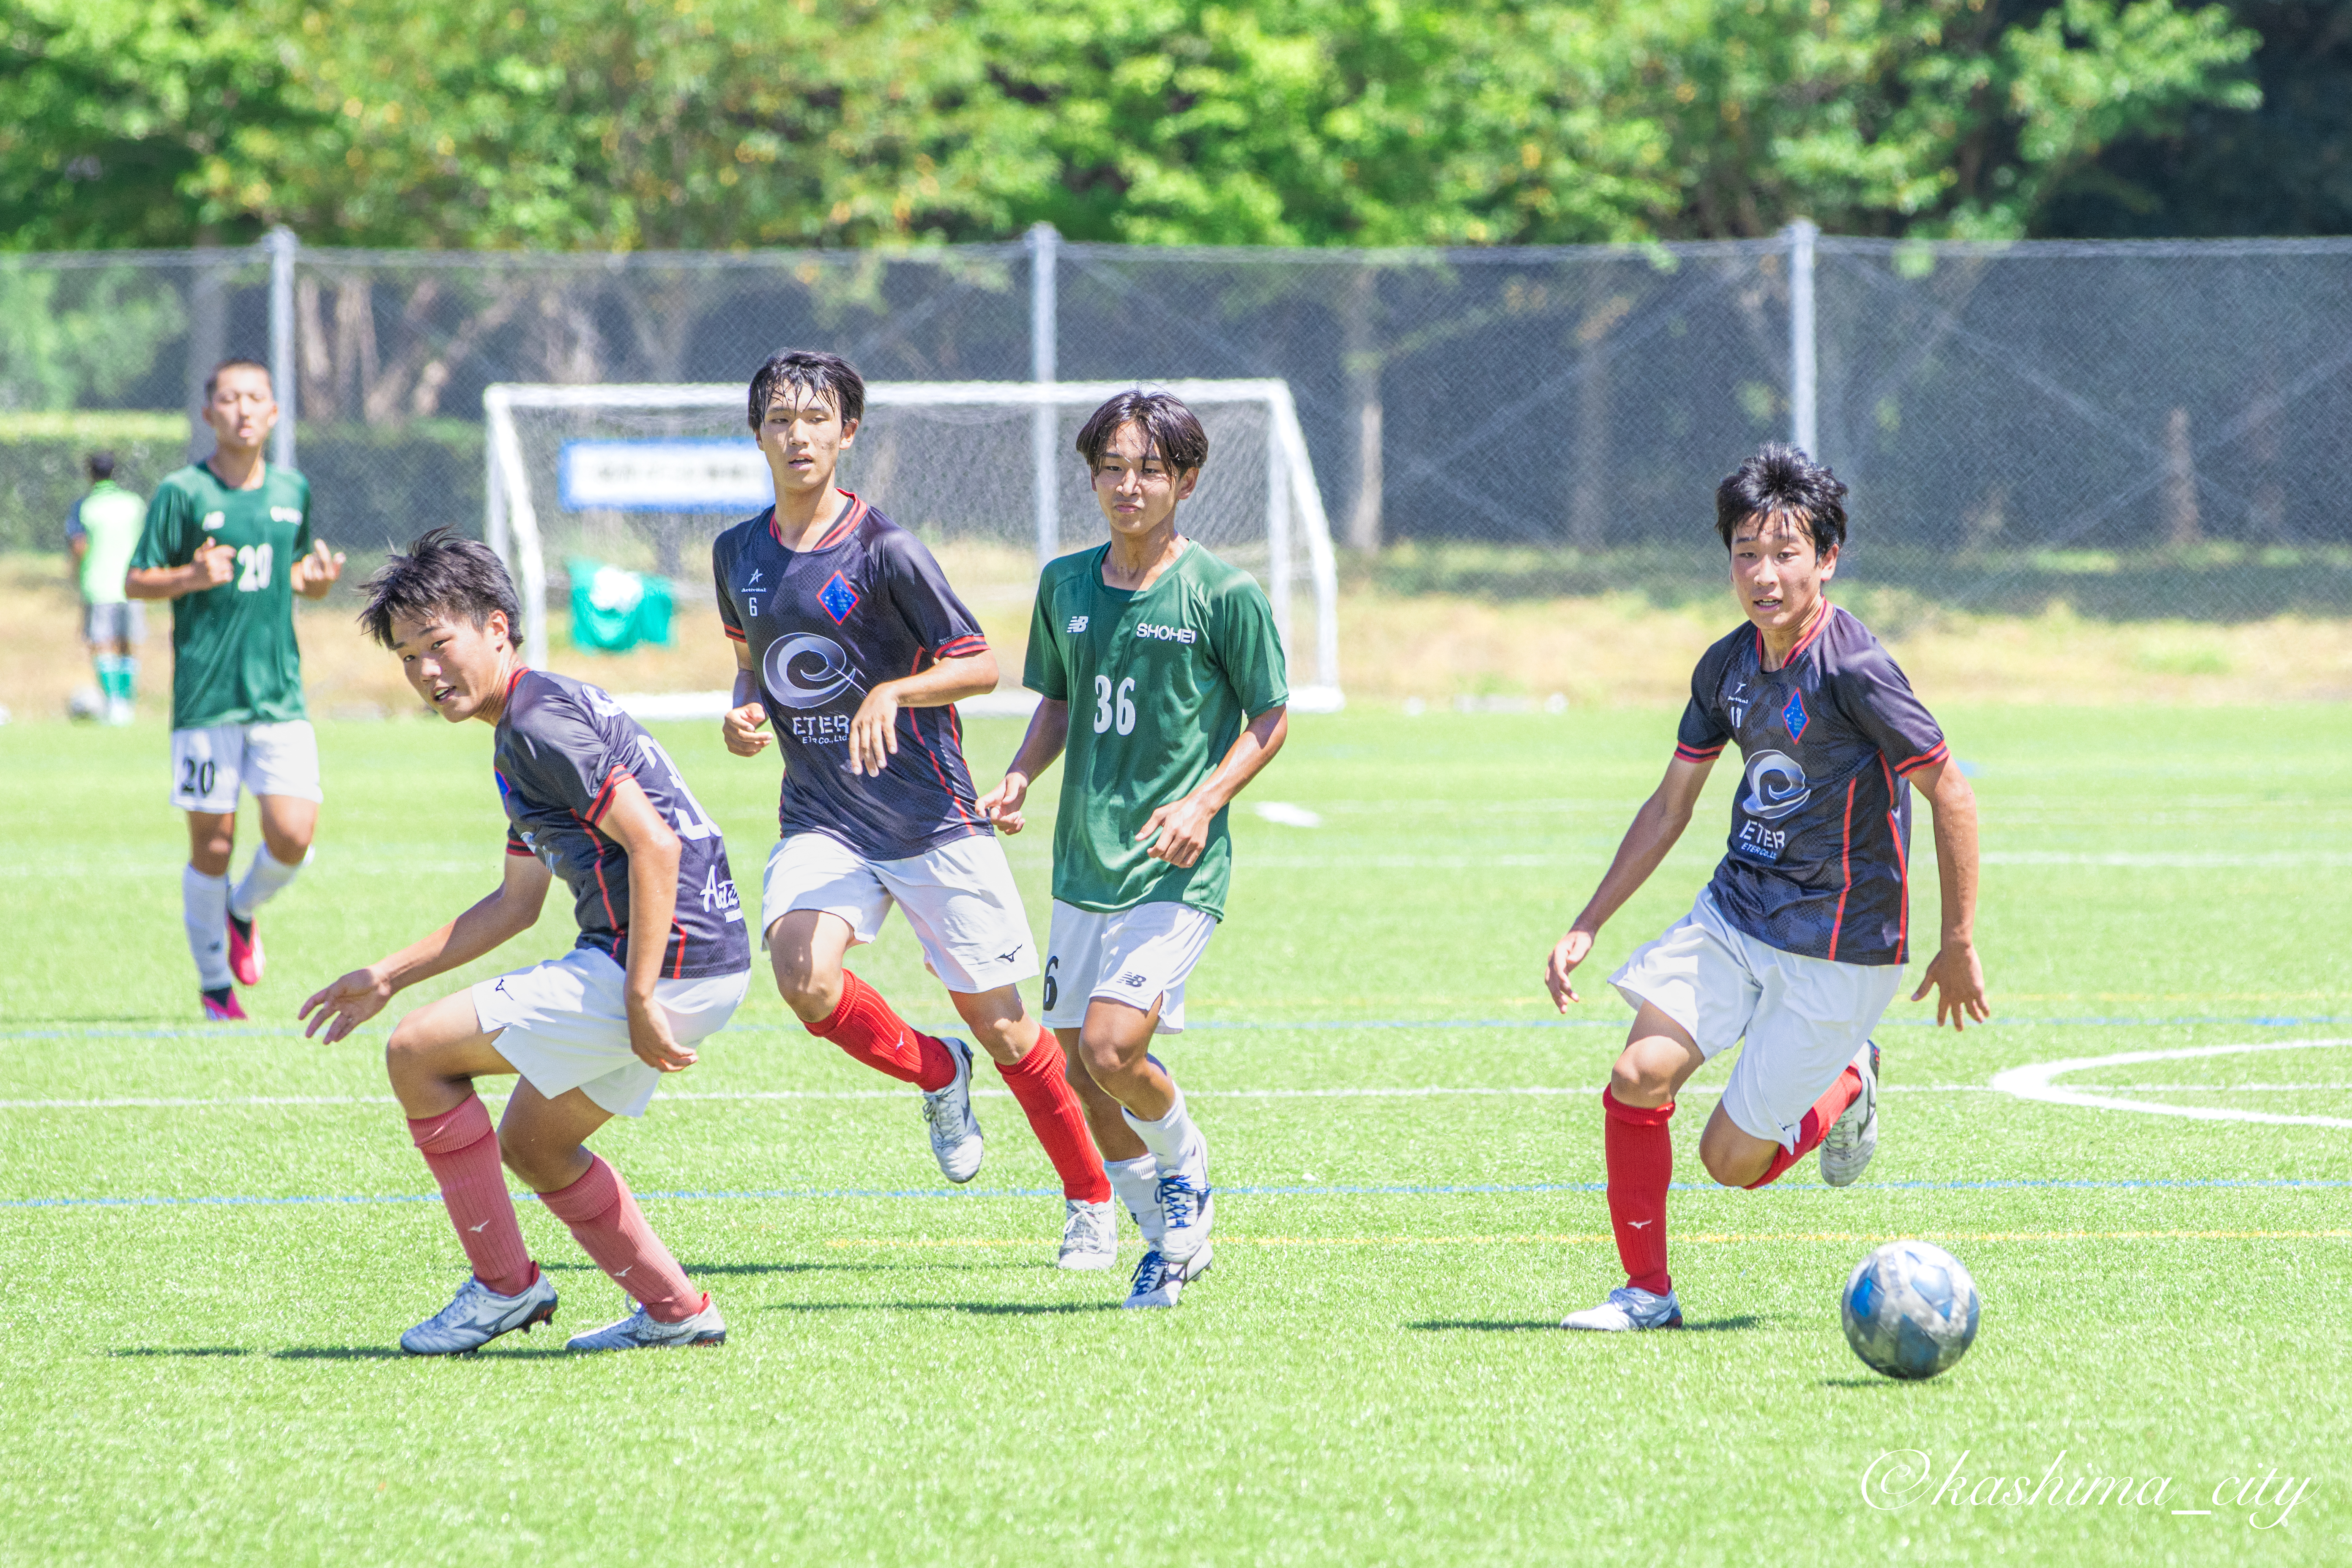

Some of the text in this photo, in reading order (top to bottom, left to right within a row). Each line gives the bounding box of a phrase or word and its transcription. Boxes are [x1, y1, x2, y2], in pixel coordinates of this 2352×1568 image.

[237, 543, 273, 592] 20
[749, 597, 758, 616] 6
[1136, 623, 1196, 644] SHOHEI
[1093, 675, 1136, 736] 36
[792, 714, 850, 736] ETER
[181, 758, 215, 796] 20
[1739, 819, 1785, 849] ETER
